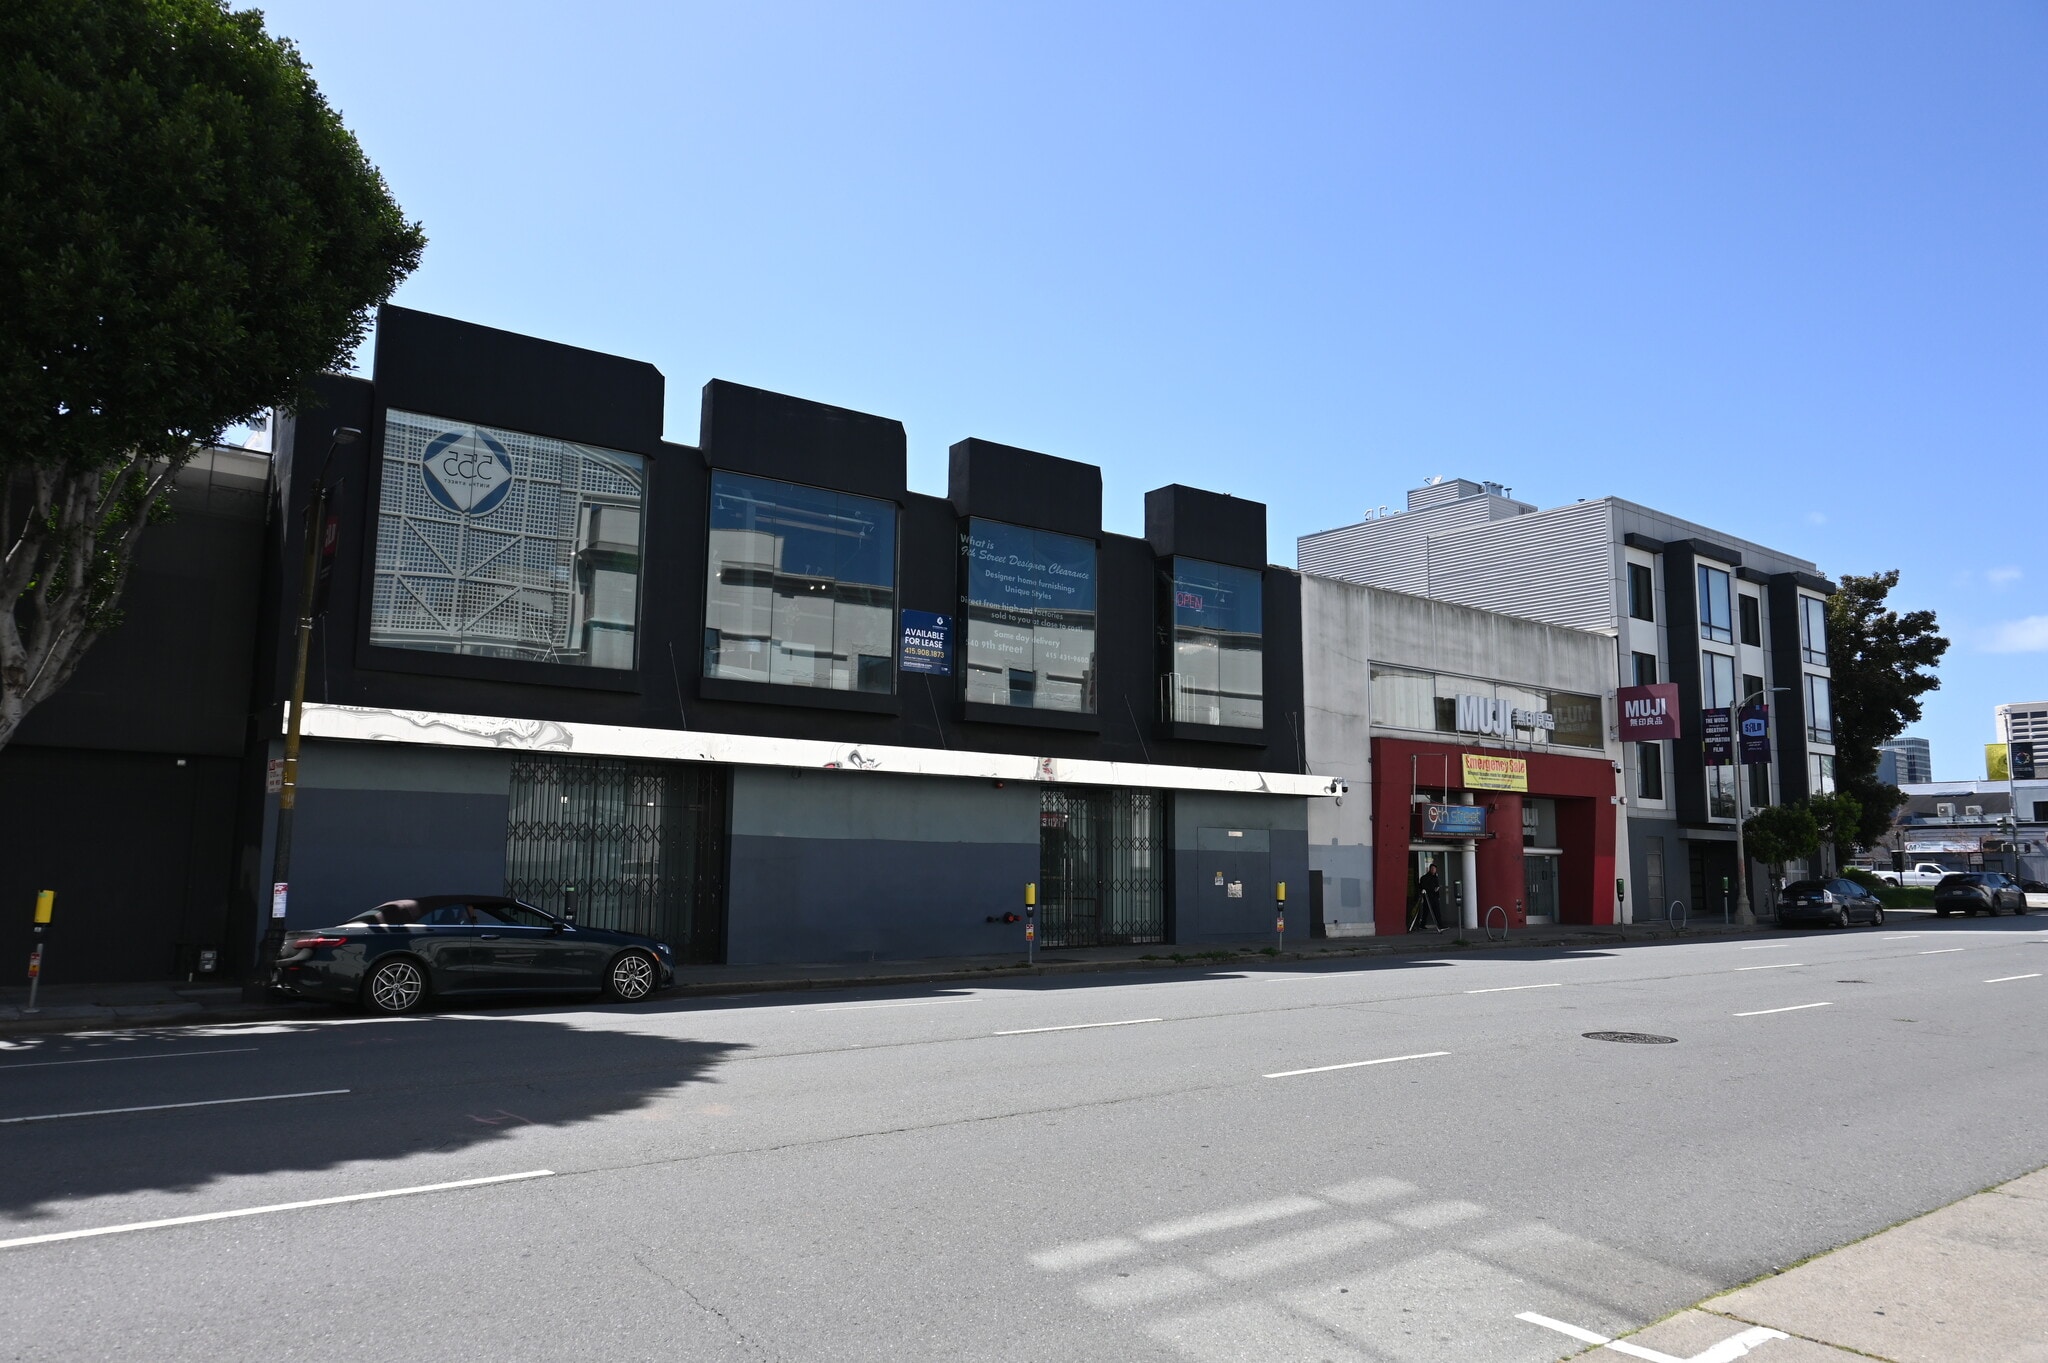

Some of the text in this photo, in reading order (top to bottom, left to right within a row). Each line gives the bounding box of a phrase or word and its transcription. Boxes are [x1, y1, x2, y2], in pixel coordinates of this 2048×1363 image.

[960, 533, 994, 550] What is
[979, 550, 1006, 564] Street
[1008, 555, 1046, 571] Designer
[1048, 563, 1090, 580] Clearance
[985, 569, 1076, 594] Designer home furnishings
[1005, 585, 1052, 601] Unique Styles
[1177, 592, 1203, 609] OPEN
[991, 611, 1007, 620] sold
[1008, 613, 1017, 621] to
[1017, 617, 1031, 625] you
[1041, 619, 1058, 629] close
[1034, 608, 1064, 620] factories
[904, 627, 945, 641] AVAILABLE
[904, 636, 943, 649] FOR LEASE
[994, 629, 1060, 648] Same day delivery
[904, 647, 945, 659] 415.908.1873
[981, 639, 996, 651] 9th
[998, 642, 1023, 655] street
[1456, 694, 1513, 736] MUJI
[1625, 697, 1666, 718] MUJI
[1630, 716, 1663, 727] 無印良品
[1465, 755, 1525, 773] Emergency Sale
[1428, 804, 1449, 831] 9th
